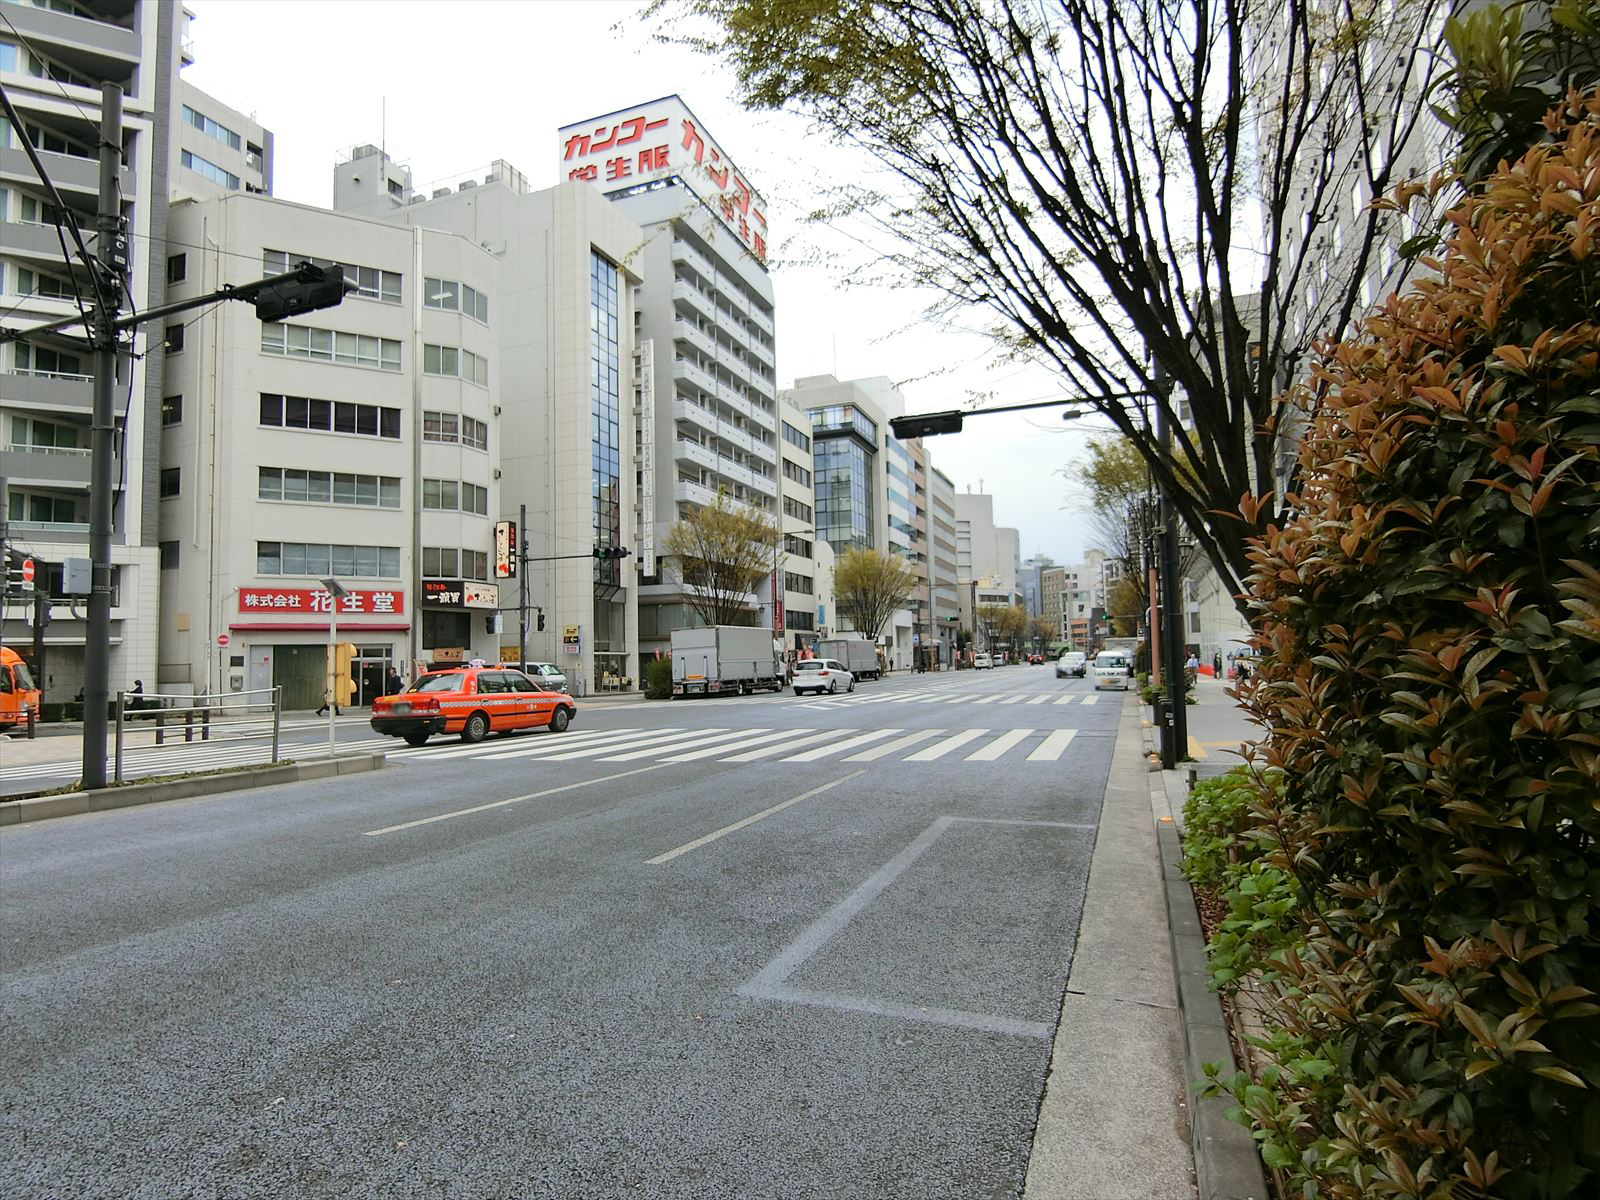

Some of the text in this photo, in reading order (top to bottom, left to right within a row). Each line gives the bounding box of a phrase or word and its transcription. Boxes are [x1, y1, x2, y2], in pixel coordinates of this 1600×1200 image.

[564, 116, 668, 160] カンコー
[569, 144, 670, 182] 学生服
[681, 118, 767, 228] カンコー
[245, 591, 395, 612] 株式会社 花生堂
